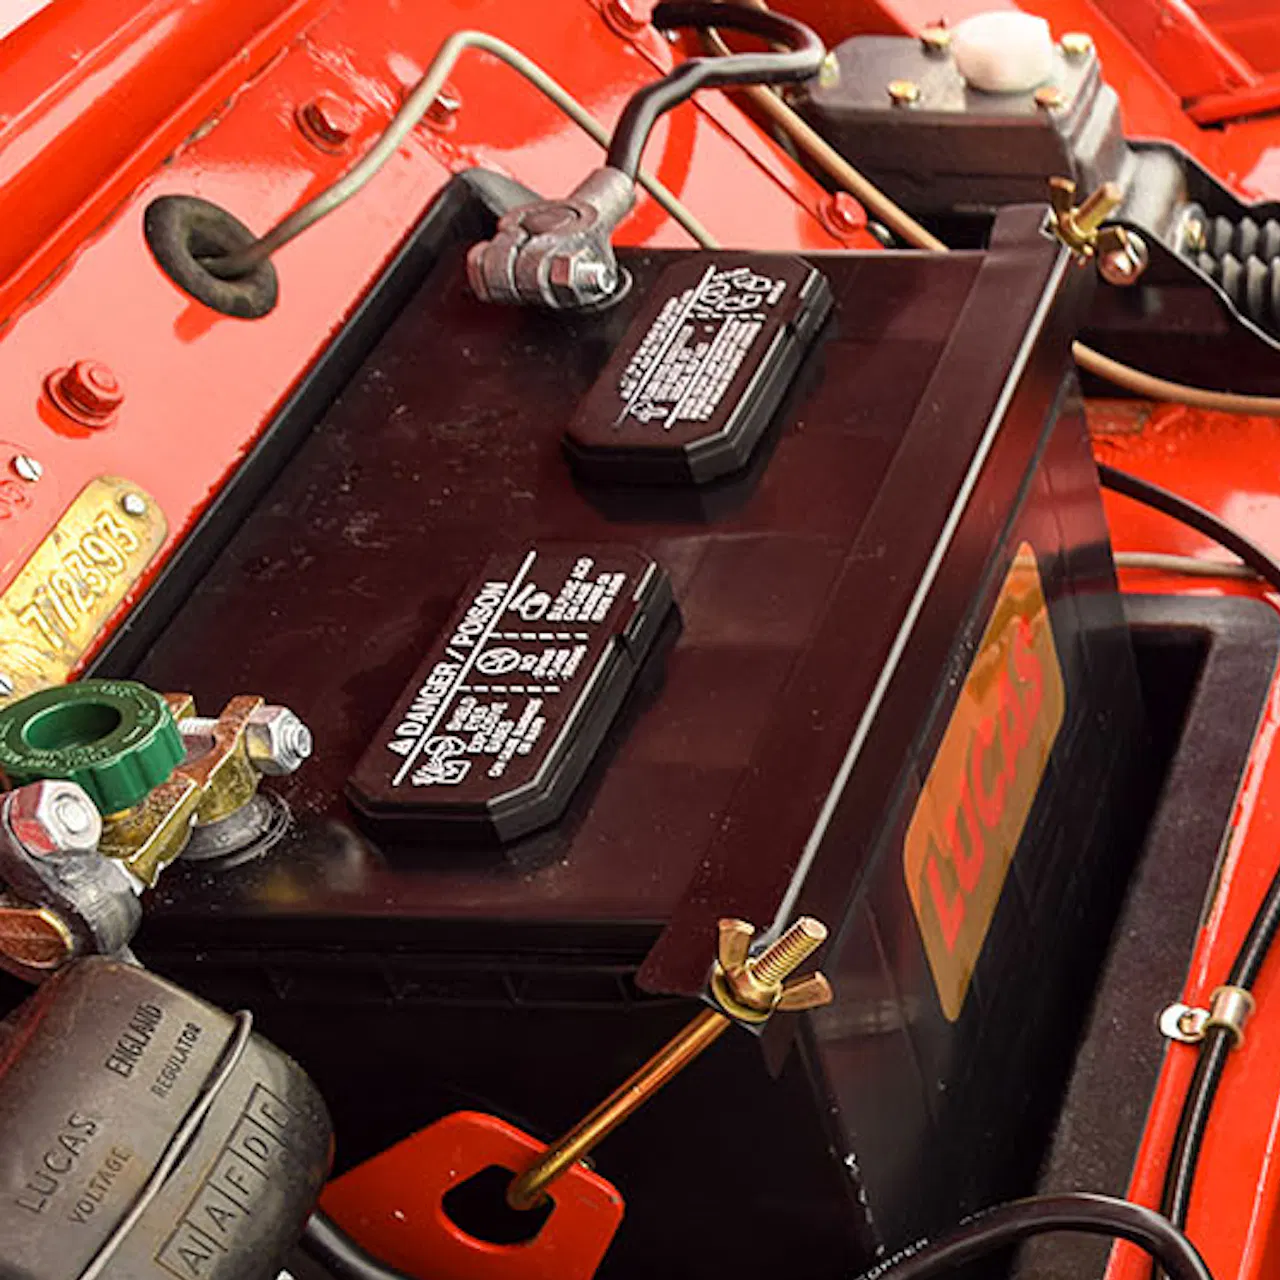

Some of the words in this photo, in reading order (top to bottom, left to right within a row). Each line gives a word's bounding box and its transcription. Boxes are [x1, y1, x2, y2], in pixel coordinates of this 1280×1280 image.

[395, 662, 461, 736] DANGER
[450, 582, 509, 647] POISON
[927, 614, 1044, 953] LUCAS
[106, 1001, 163, 1079] ENGLAND
[14, 1111, 98, 1215] LUCAS
[68, 1144, 133, 1225] VOLTAGE
[151, 1022, 203, 1099] REGULATOR
